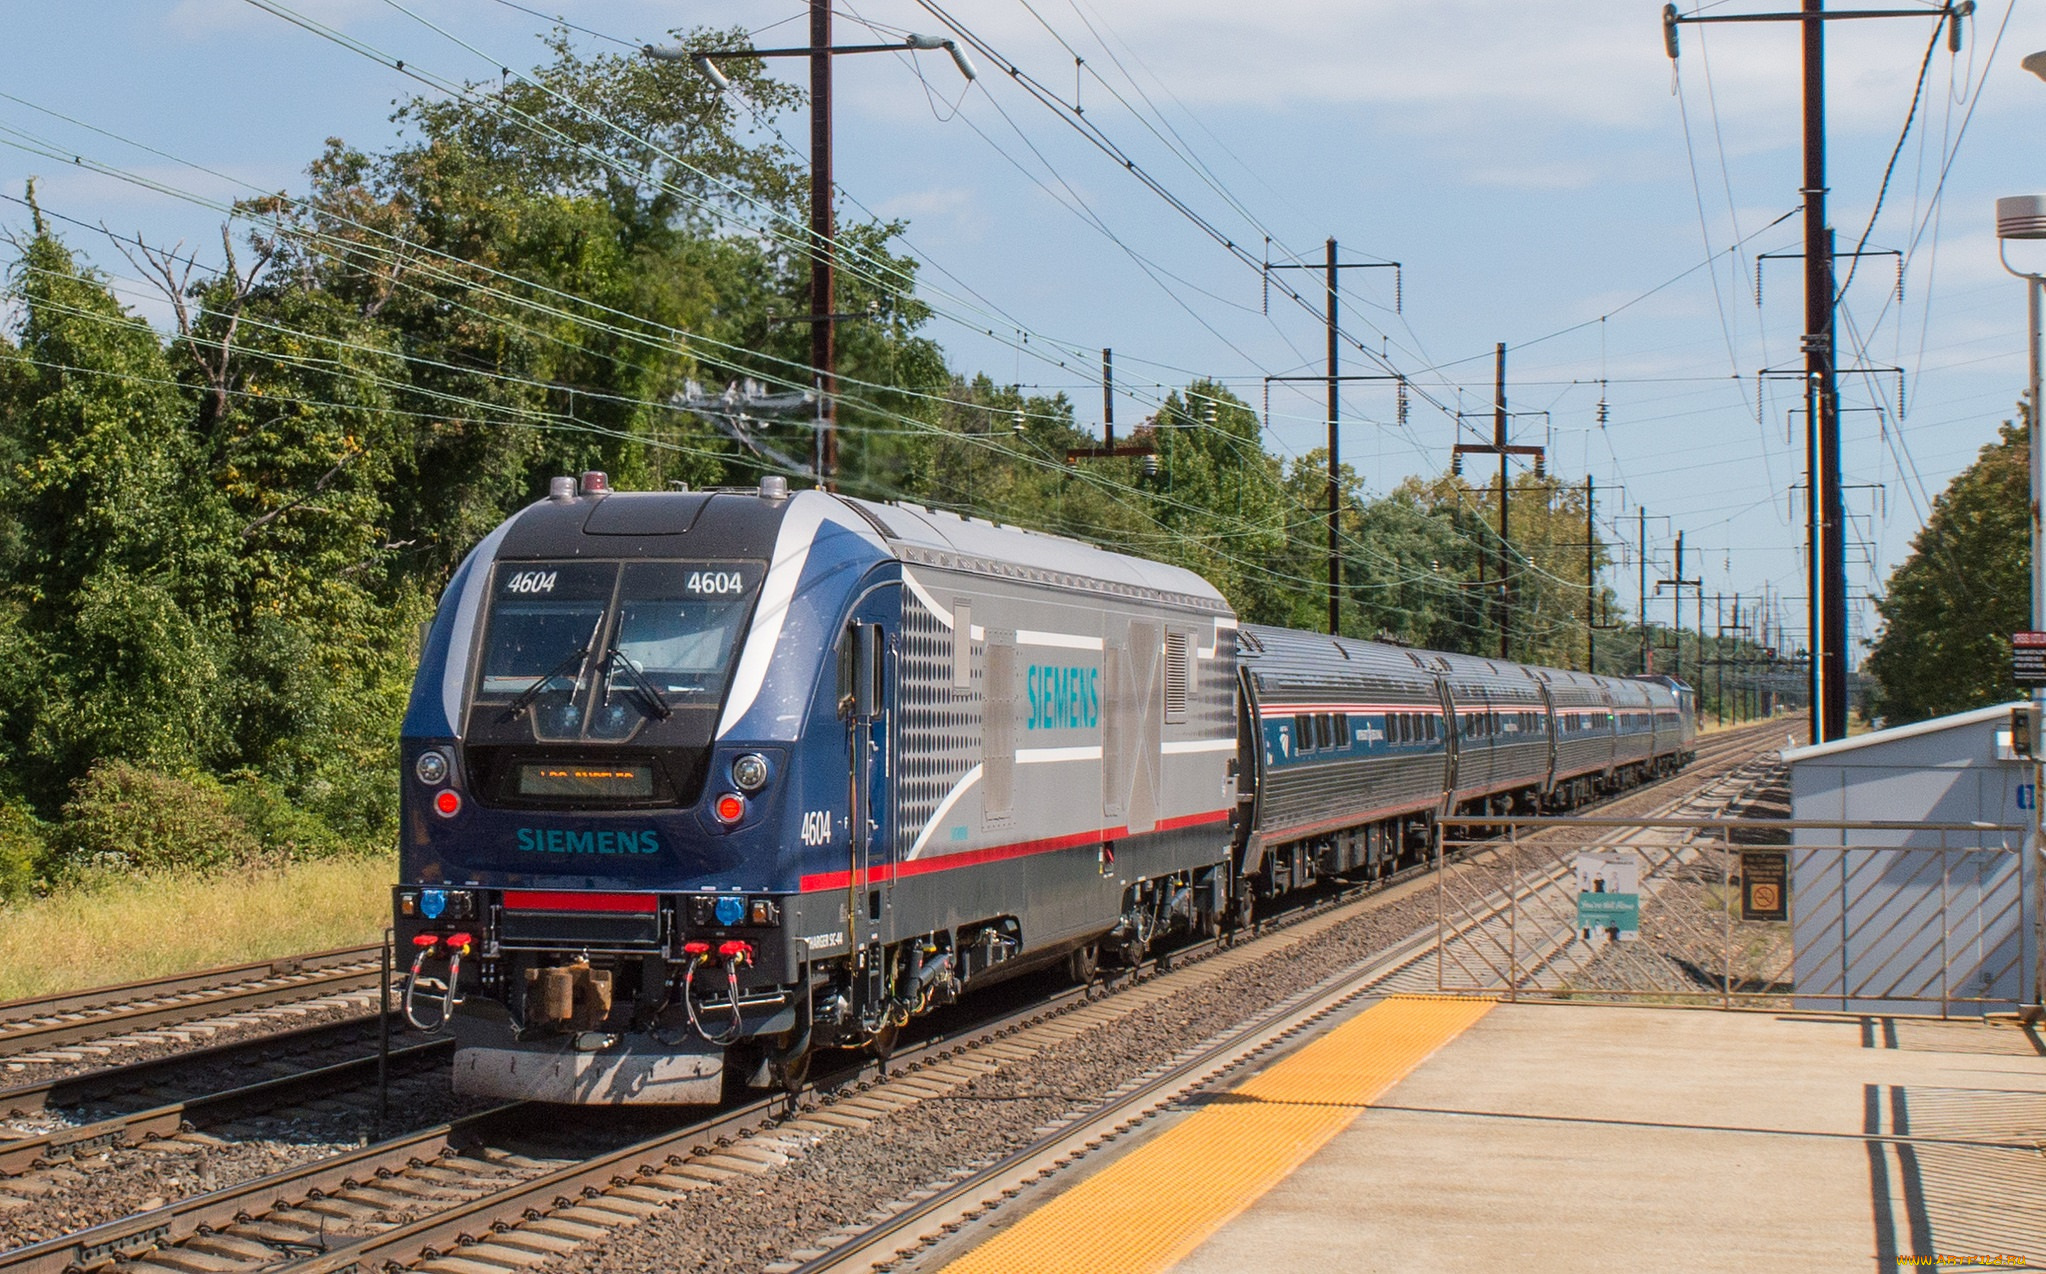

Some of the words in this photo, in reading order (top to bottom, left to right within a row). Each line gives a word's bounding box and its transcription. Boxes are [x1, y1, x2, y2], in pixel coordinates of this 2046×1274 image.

[508, 571, 557, 593] 4604
[687, 571, 743, 594] 4604
[1027, 664, 1099, 731] SIEMENS
[516, 828, 660, 854] SIEMENS
[800, 810, 832, 846] 4604
